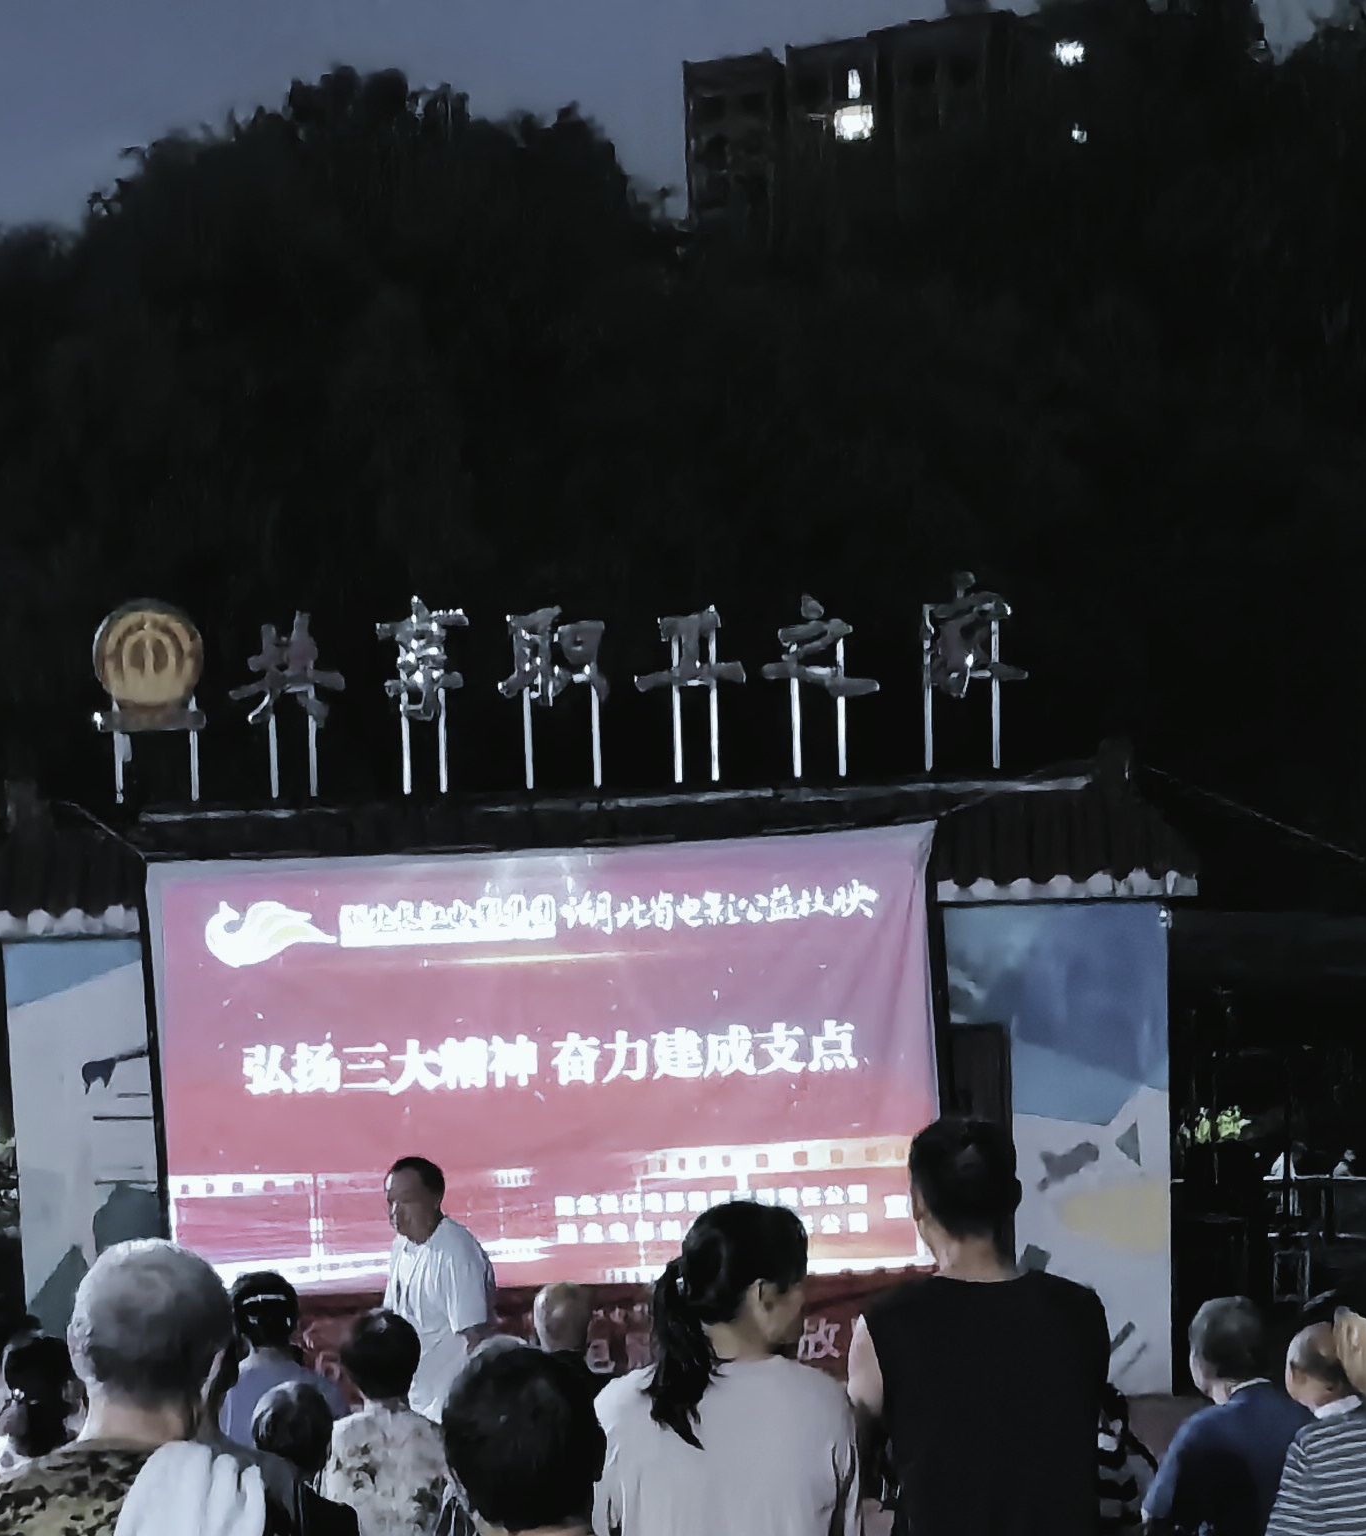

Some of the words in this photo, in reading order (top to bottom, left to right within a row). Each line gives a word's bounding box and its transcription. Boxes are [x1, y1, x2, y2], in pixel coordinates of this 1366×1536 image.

[242, 1033, 538, 1096] 弘扬三大精神
[551, 1019, 859, 1086] 奋力建成支点
